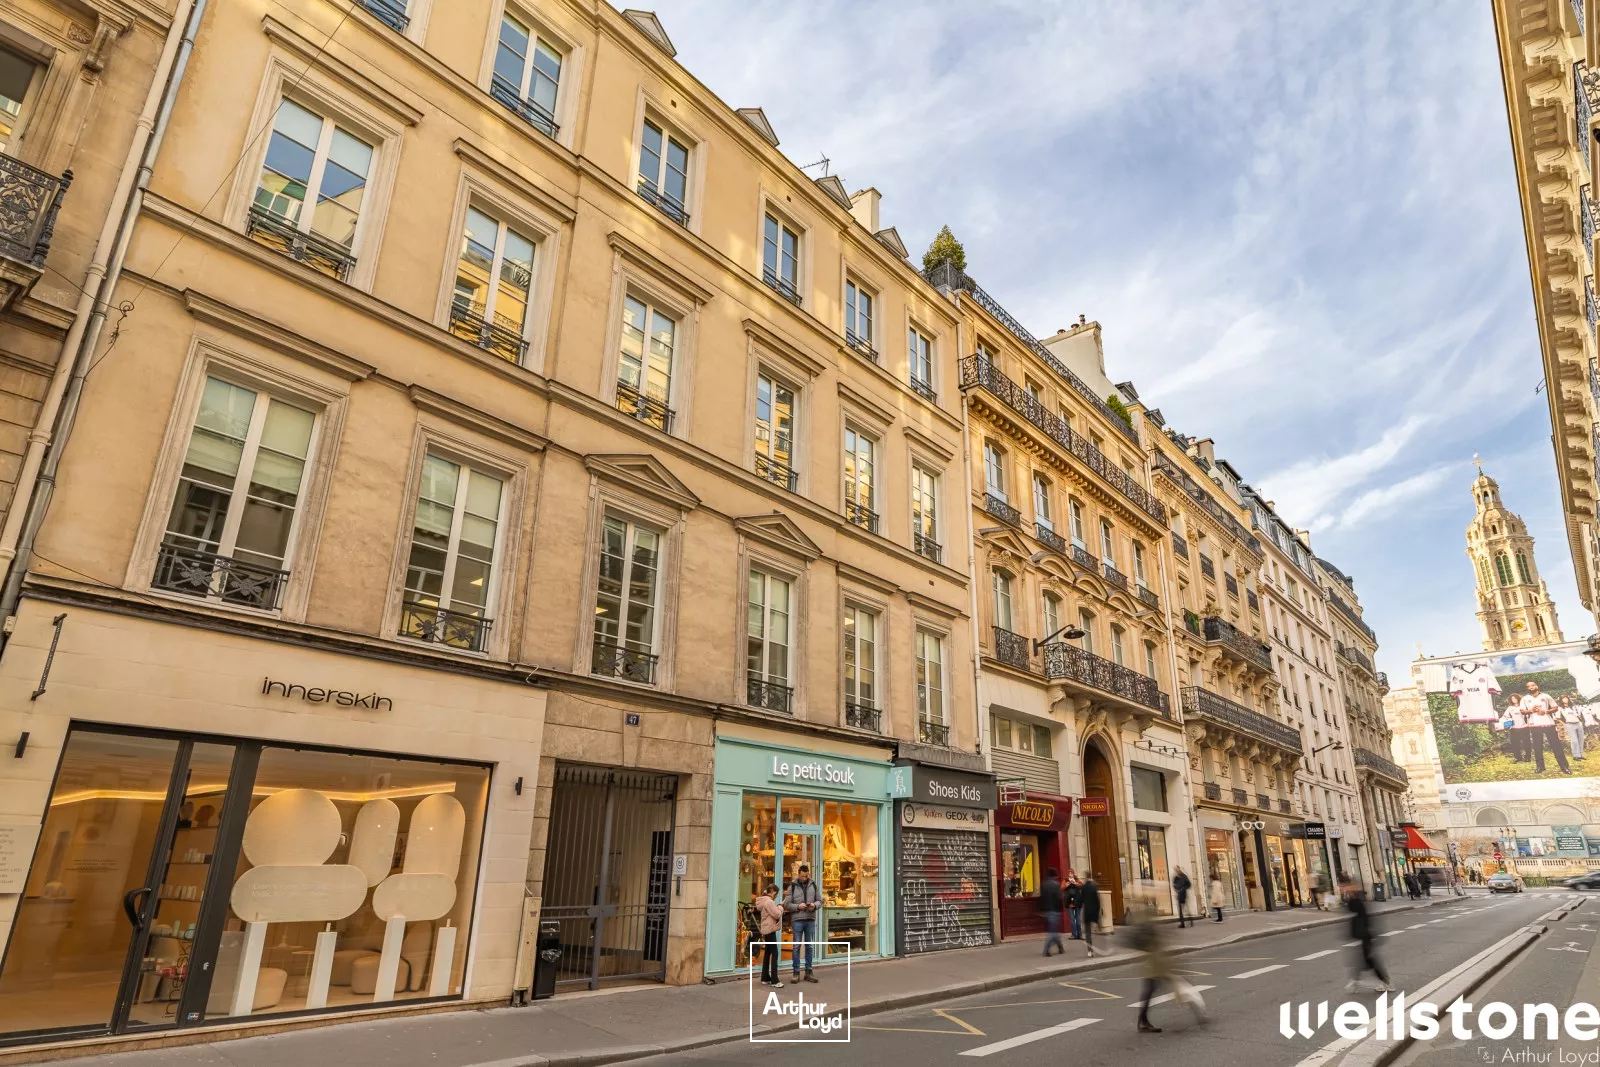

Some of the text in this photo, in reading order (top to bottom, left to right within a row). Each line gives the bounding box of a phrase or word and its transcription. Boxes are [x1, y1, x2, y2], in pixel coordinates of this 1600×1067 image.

[262, 677, 392, 711] innerskin
[629, 715, 637, 724] 47
[773, 755, 855, 785] Le petit Souk
[929, 780, 981, 801] Shoes Kids
[945, 811, 968, 821] GEOX
[1014, 805, 1052, 822] NICOLAS
